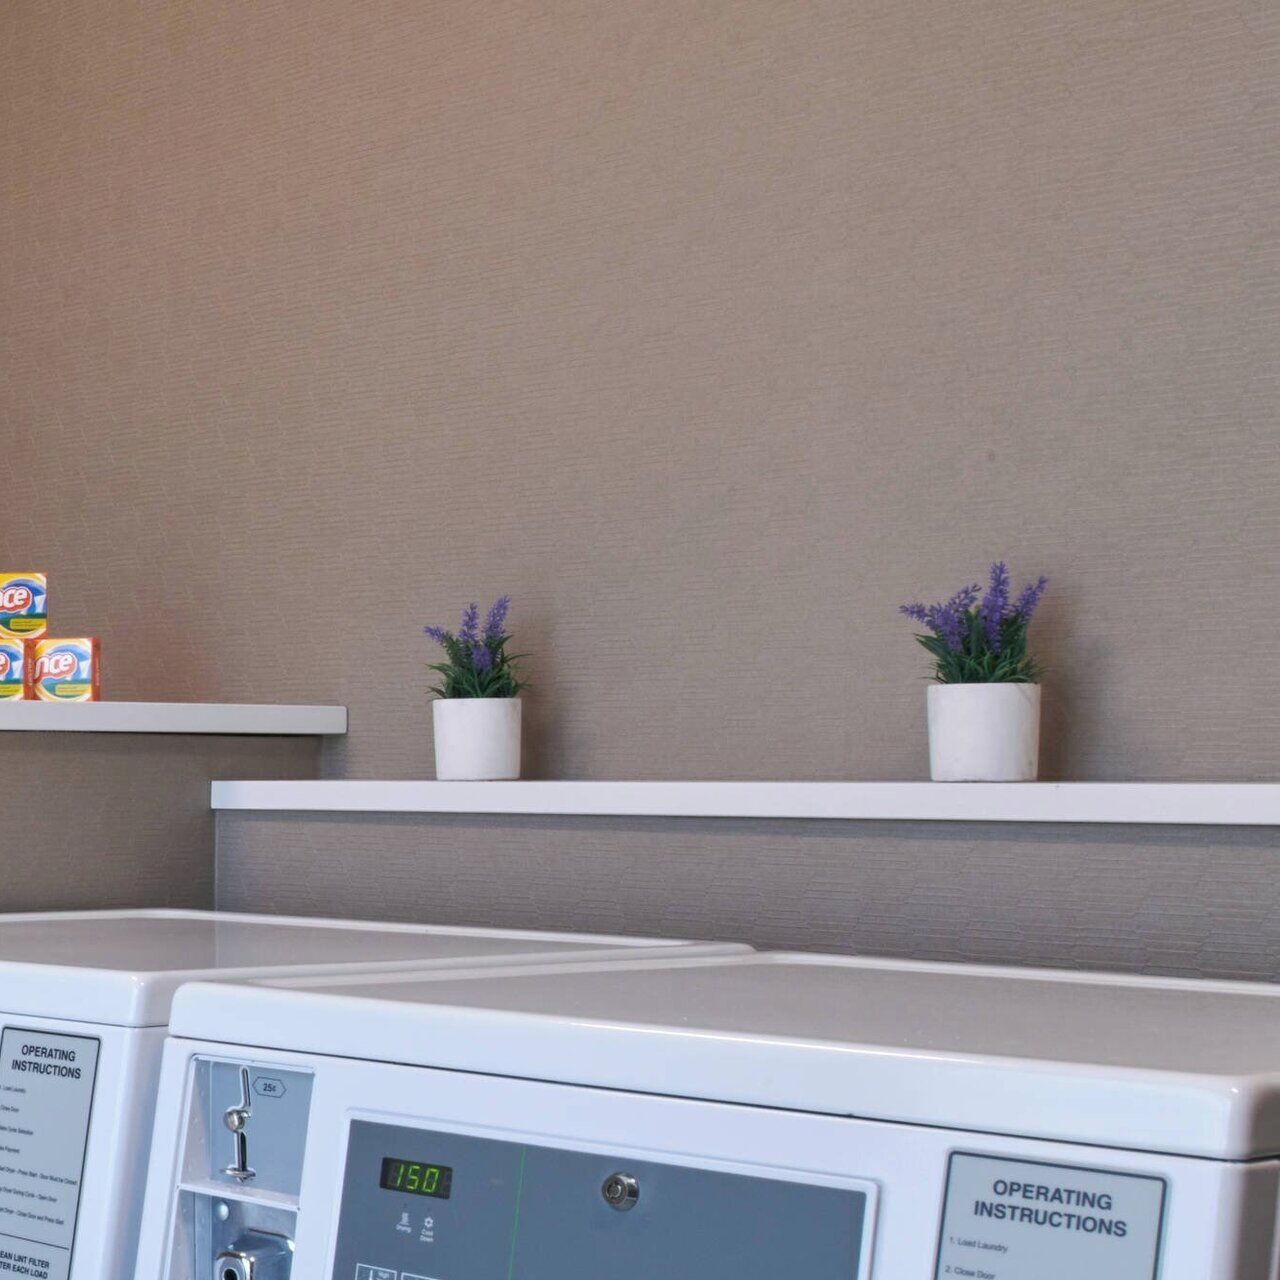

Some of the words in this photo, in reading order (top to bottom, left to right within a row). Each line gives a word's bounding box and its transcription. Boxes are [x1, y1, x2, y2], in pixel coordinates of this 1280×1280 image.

[35, 653, 76, 680] nce
[21, 1044, 76, 1062] OPERATING
[11, 1059, 82, 1079] INSTRUCTIONS
[396, 1164, 439, 1193] 150
[993, 1179, 1113, 1211] OPERATING
[974, 1200, 1127, 1237] INSTRUCTIONS
[957, 1237, 976, 1248] Load
[977, 1240, 1008, 1254] Laundry
[13, 1254, 28, 1263] LINT
[28, 1258, 50, 1269] FILTER
[12, 1264, 30, 1275] EACH
[30, 1269, 48, 1280] LOAD
[954, 1266, 975, 1277] Close
[976, 1270, 996, 1280] Door
